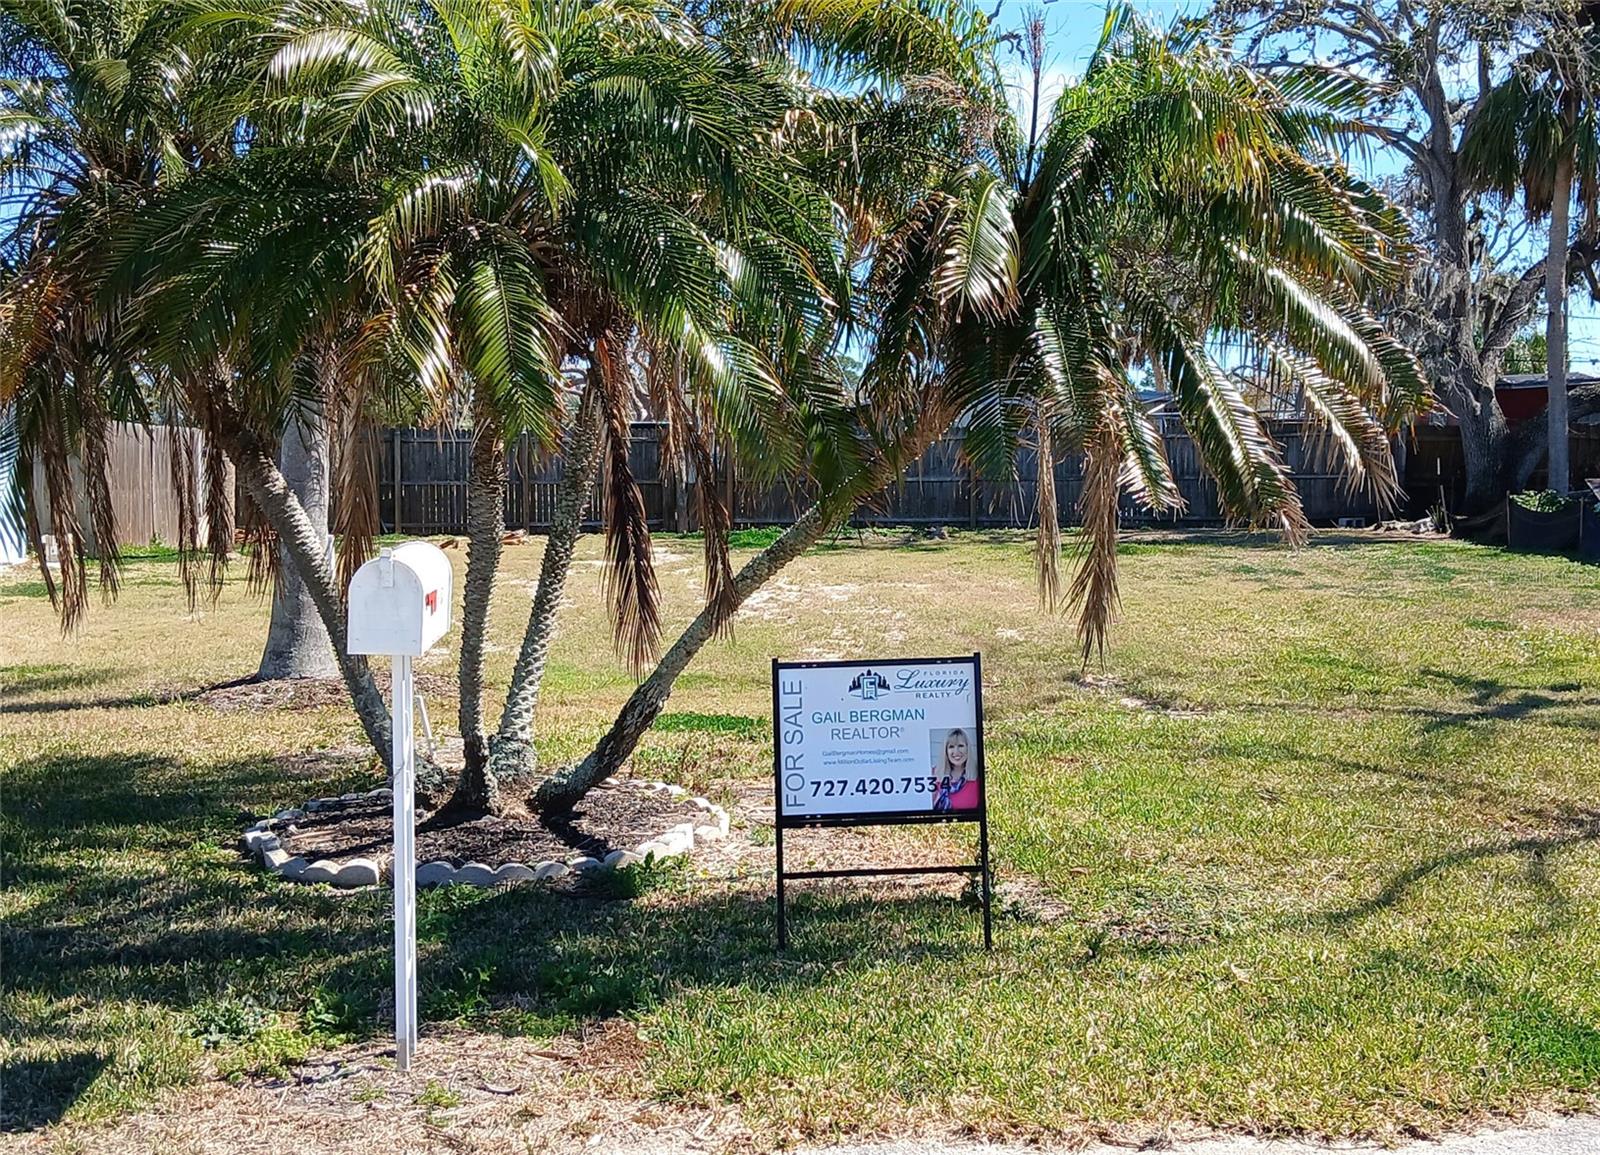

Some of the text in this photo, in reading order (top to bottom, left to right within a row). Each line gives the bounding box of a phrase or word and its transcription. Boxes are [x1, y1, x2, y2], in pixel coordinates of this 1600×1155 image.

[894, 669, 969, 696] Luxury
[811, 708, 925, 724] GAIL BERGMAN
[783, 679, 806, 808] FOR SALE
[810, 776, 951, 798] 727.420.7534
